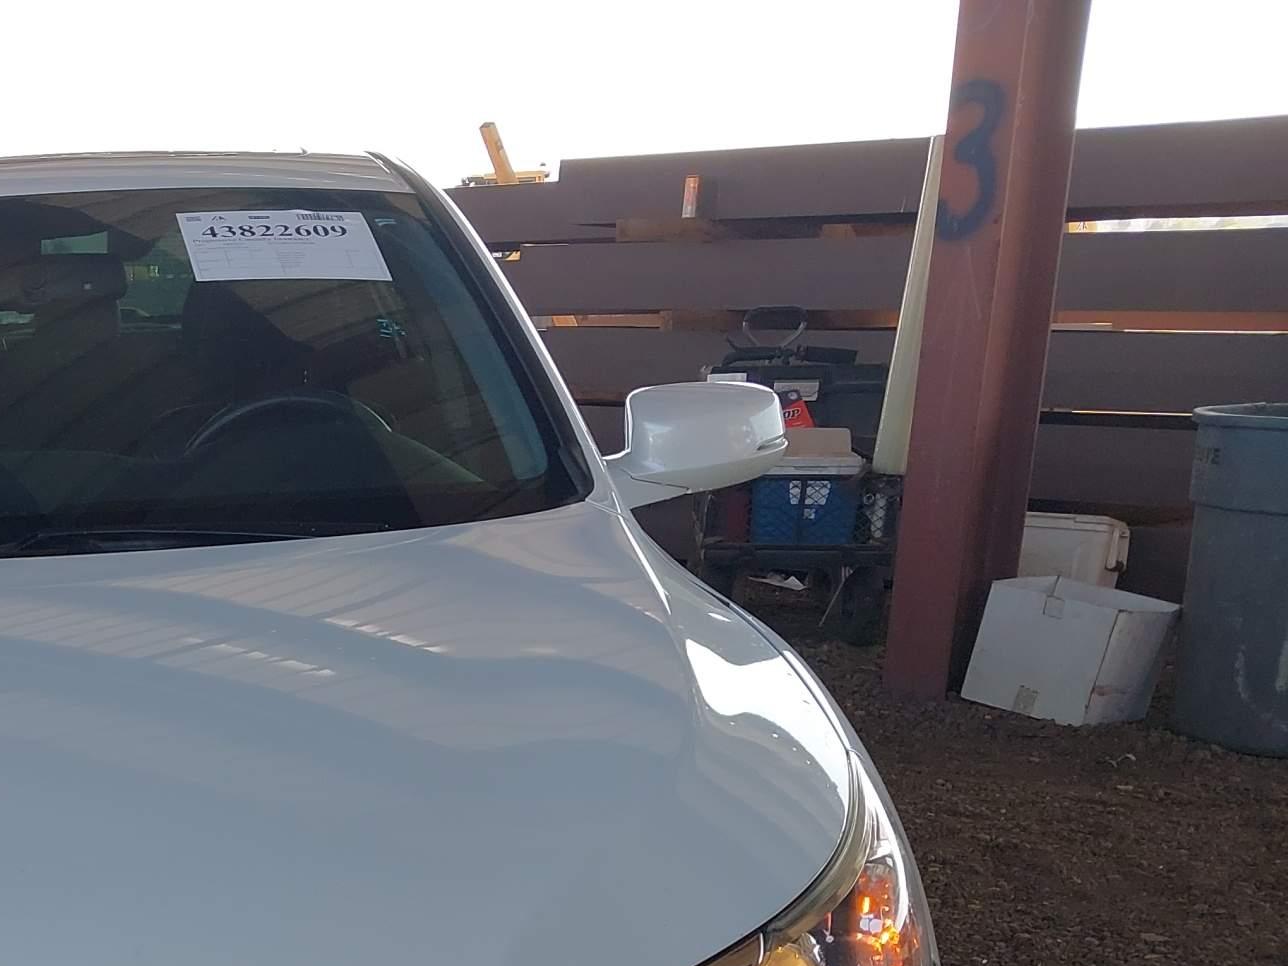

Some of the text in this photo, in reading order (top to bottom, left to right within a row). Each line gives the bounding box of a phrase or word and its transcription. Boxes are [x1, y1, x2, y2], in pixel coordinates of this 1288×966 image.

[936, 79, 1005, 242] 3
[201, 224, 348, 239] 43822609
[782, 408, 802, 420] OP
